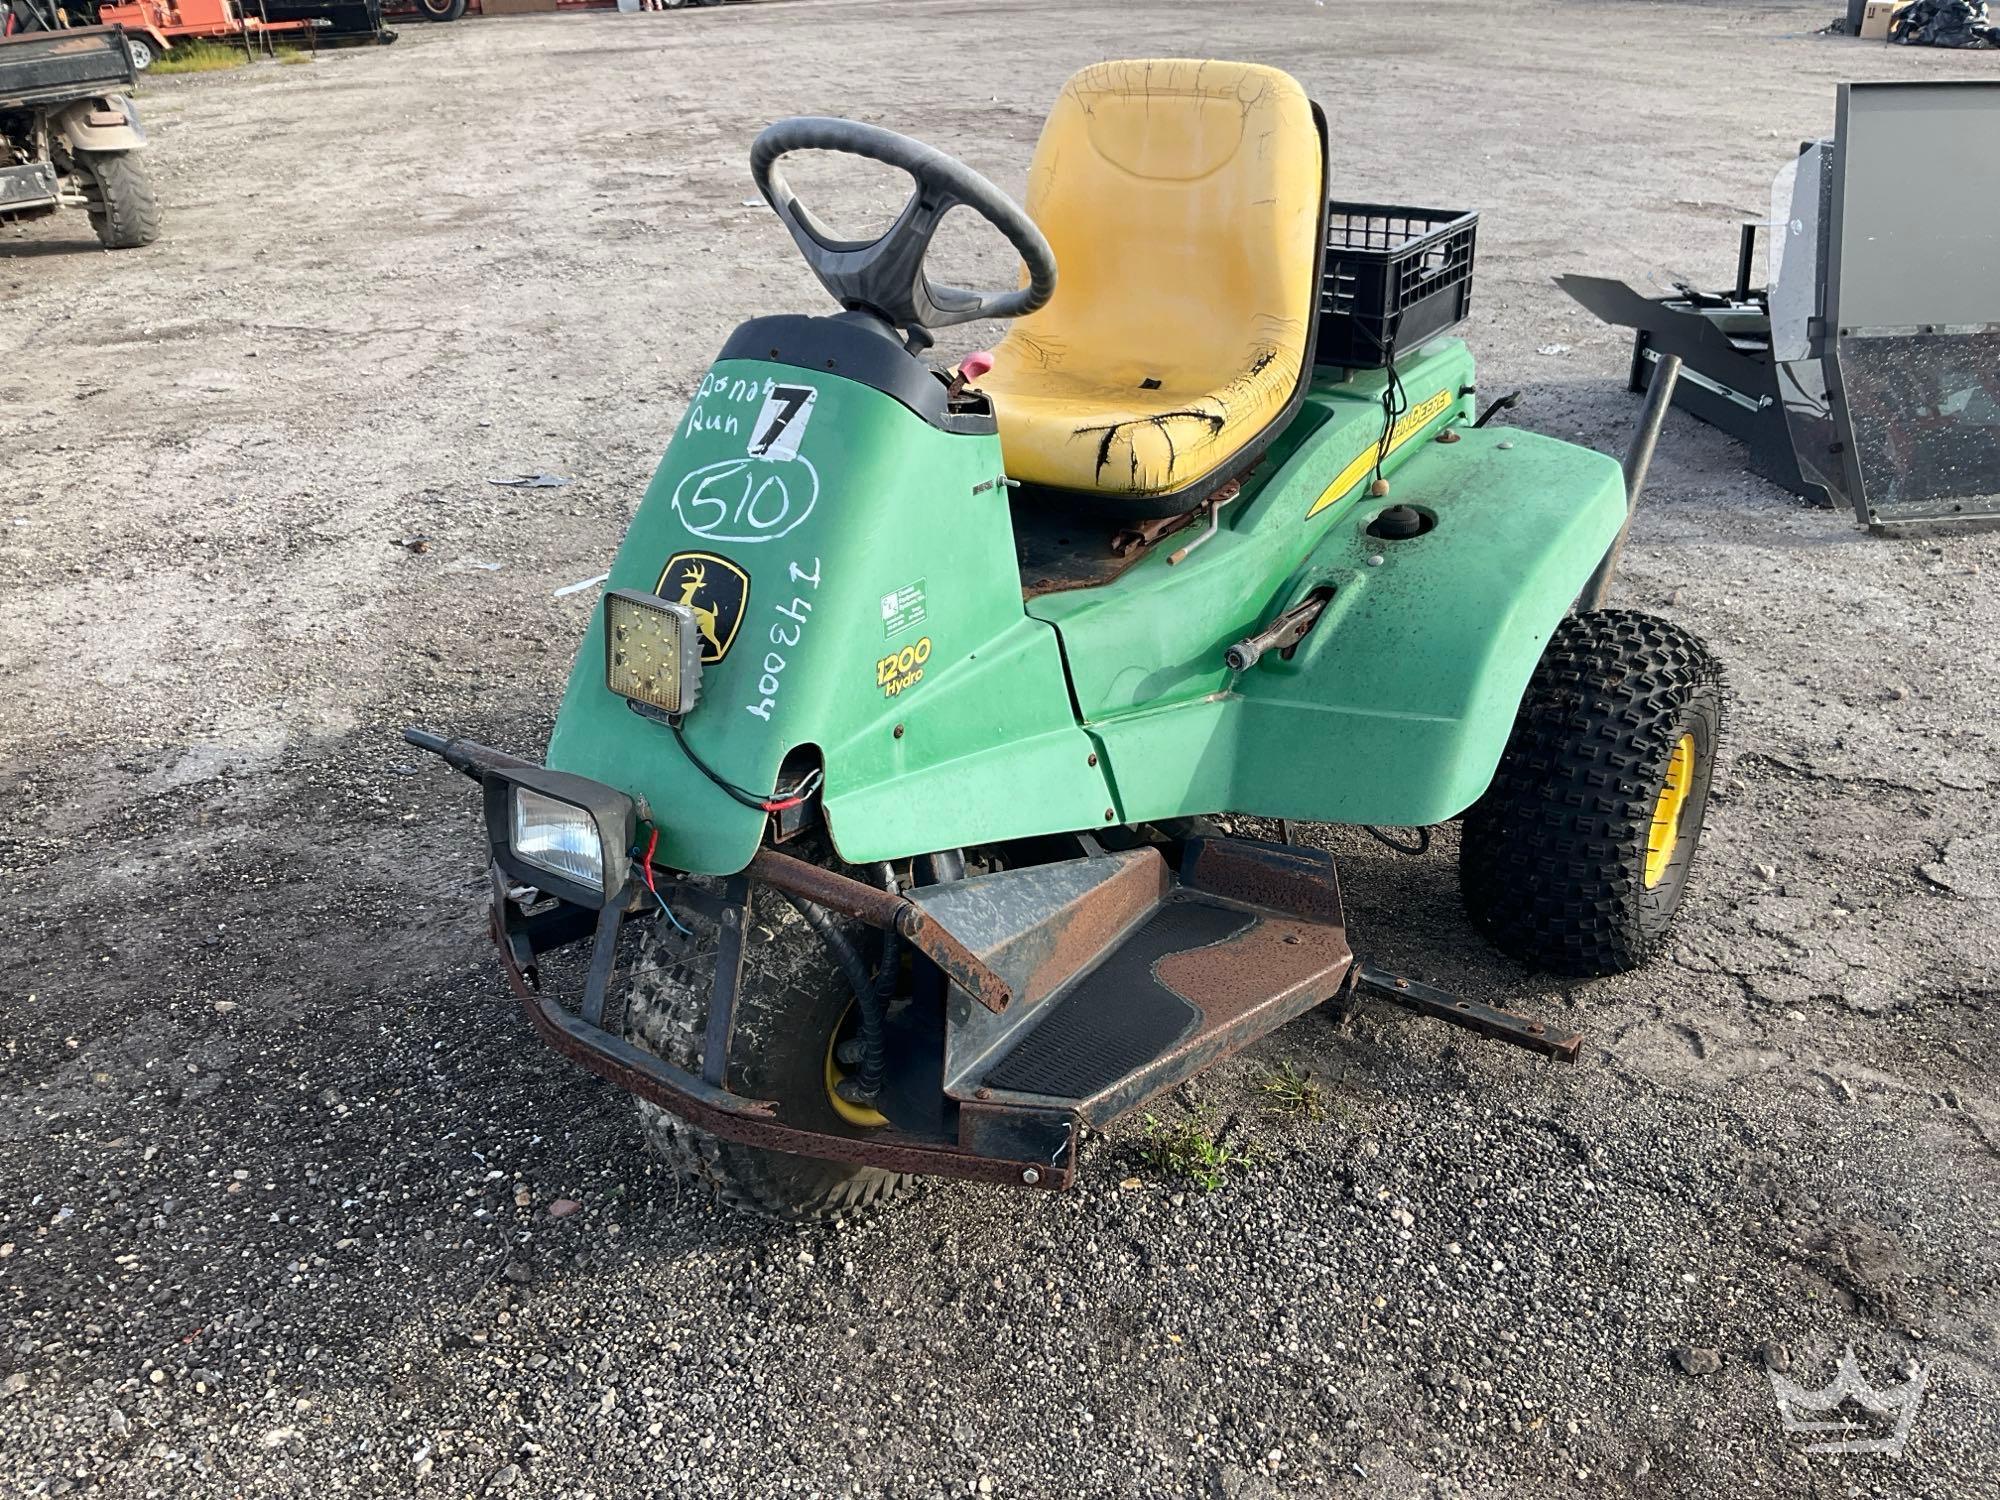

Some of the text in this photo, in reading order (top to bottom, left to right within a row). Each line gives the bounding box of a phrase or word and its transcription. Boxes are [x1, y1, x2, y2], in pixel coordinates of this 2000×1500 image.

[686, 405, 738, 439] Run
[751, 387, 814, 456] 7
[692, 463, 789, 531] 510
[877, 637, 931, 687] 1200
[885, 669, 923, 697] Hydro
